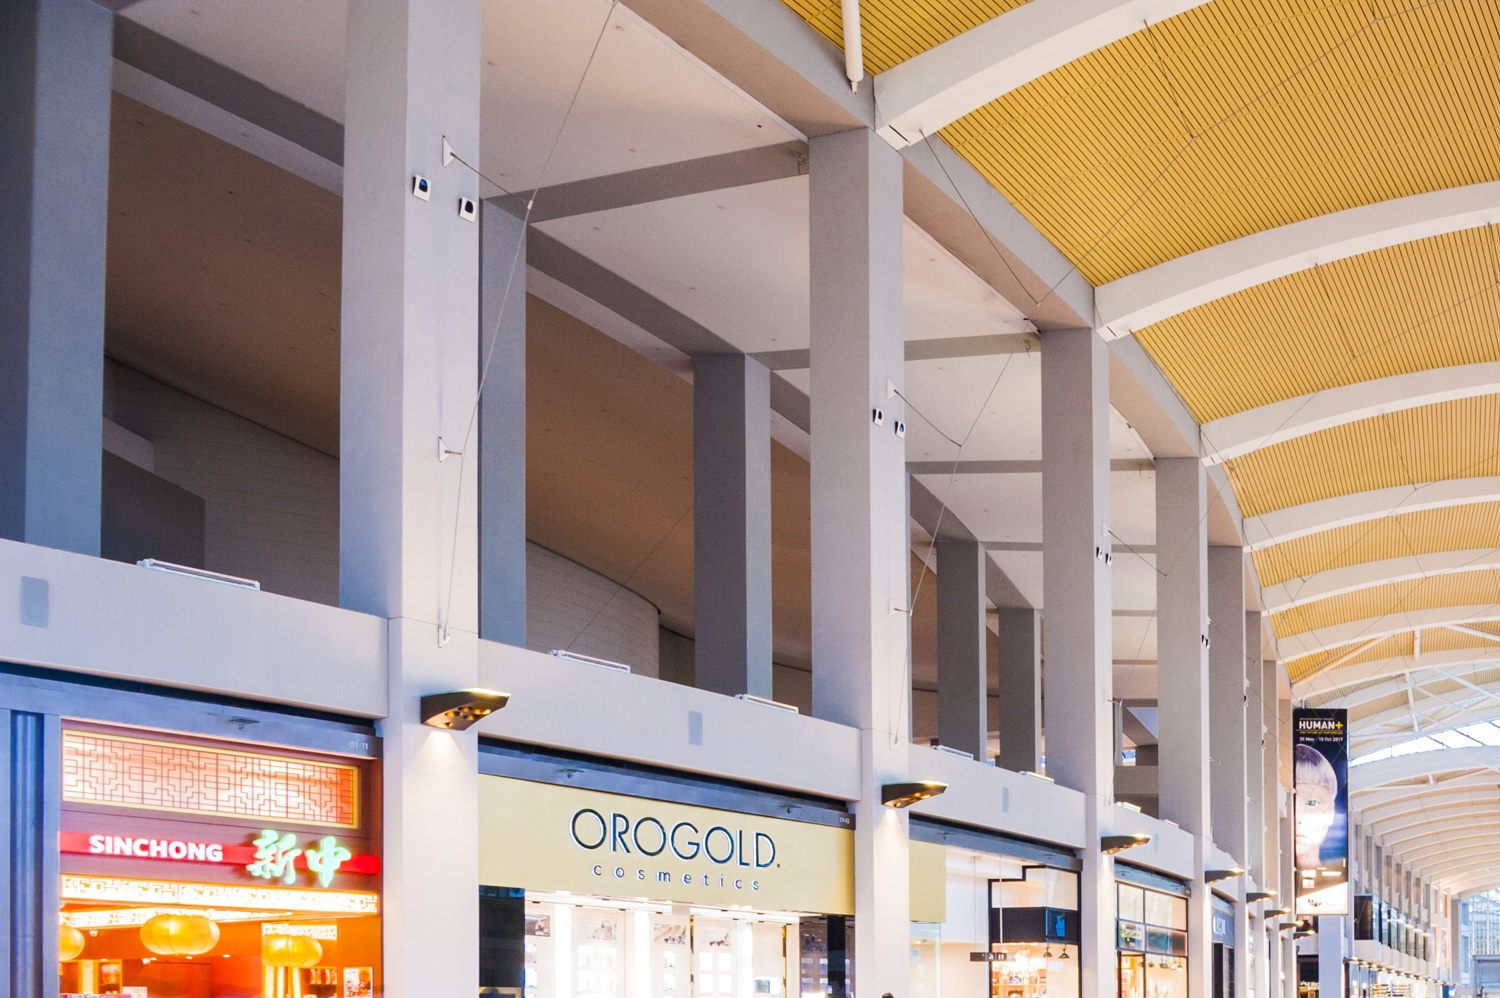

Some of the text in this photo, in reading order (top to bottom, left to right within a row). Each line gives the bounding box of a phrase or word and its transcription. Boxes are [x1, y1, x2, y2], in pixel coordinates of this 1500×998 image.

[89, 835, 223, 862] SINCHONG
[246, 829, 351, 888] 新中
[591, 864, 759, 890] cosmetics
